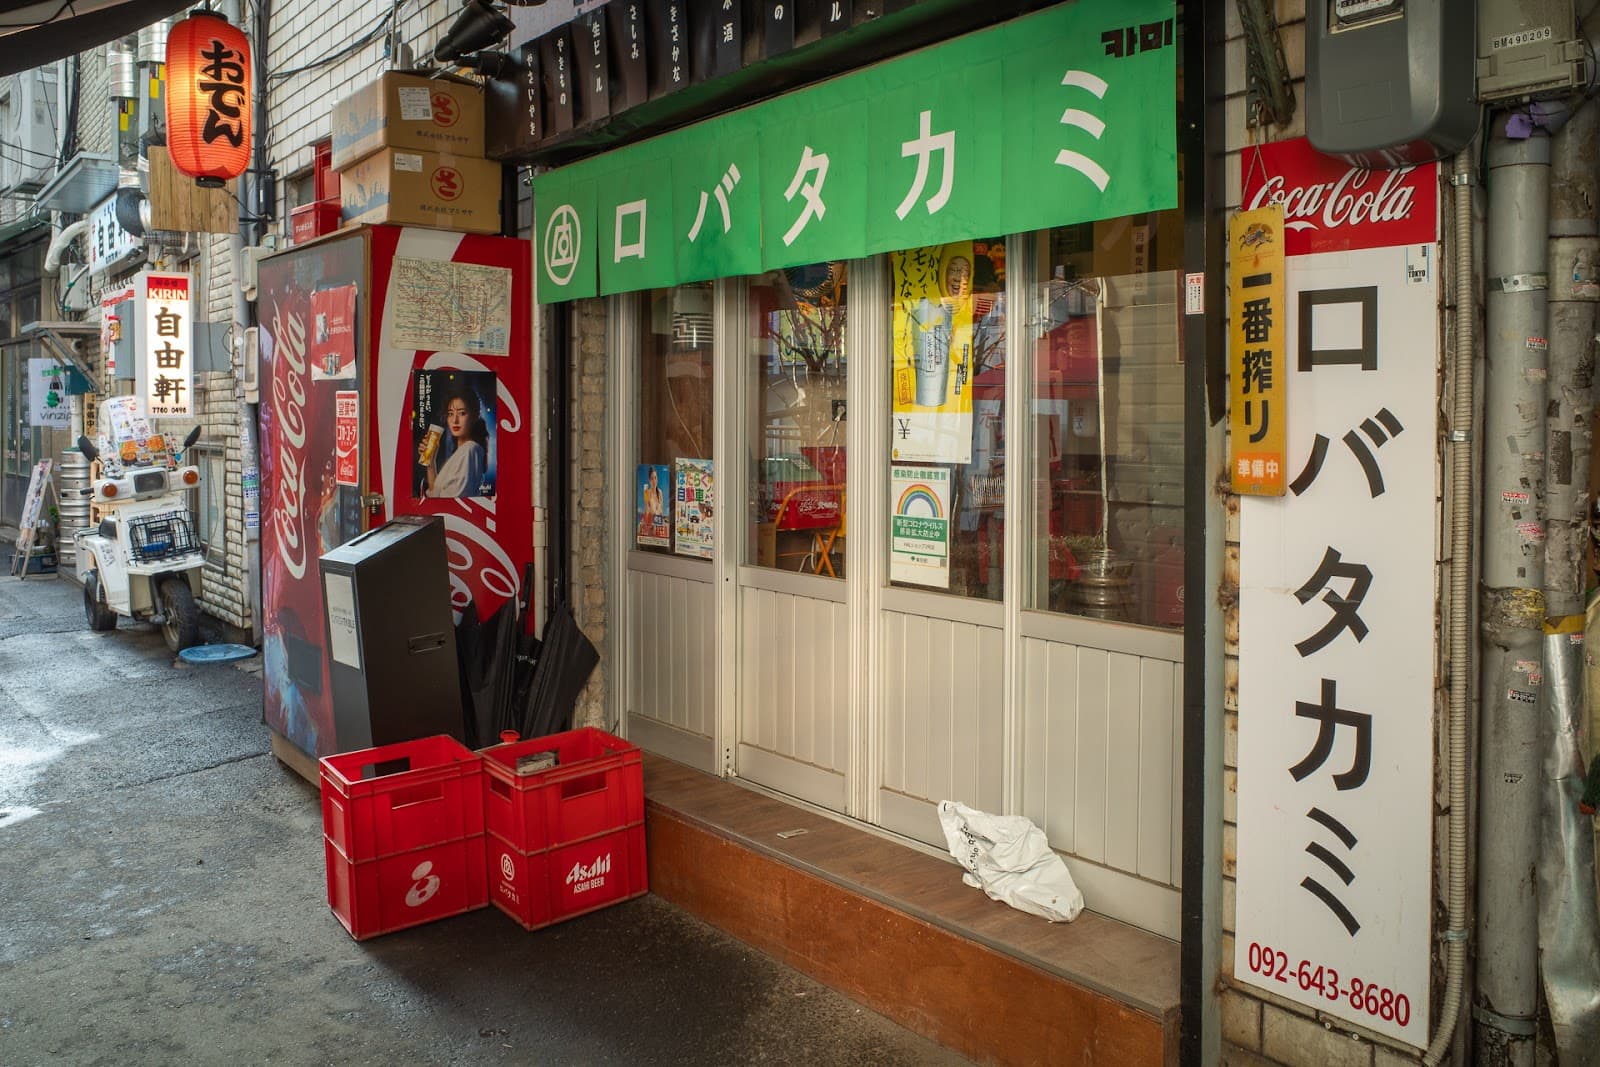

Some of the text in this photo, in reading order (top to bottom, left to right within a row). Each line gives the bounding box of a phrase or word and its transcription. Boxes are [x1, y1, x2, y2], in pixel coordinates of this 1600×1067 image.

[591, 21, 603, 93] 生ビール
[630, 4, 639, 60] さしみ
[670, 0, 681, 82] きざかな
[1101, 18, 1173, 58] 카미
[199, 39, 246, 148] おでん
[613, 69, 1111, 264] ロバタカミ
[1246, 164, 1412, 232] Coca-Cola
[148, 287, 187, 300] KIRIN
[152, 306, 187, 404] 自由軒
[1242, 272, 1273, 444] 一番搾り
[272, 299, 307, 580] Coca-Cola
[1287, 285, 1405, 937] ロバタカミ
[565, 852, 611, 885] Asahi
[574, 876, 604, 895] ASAHI BEER
[1248, 940, 1410, 1027] 092-643-8680
